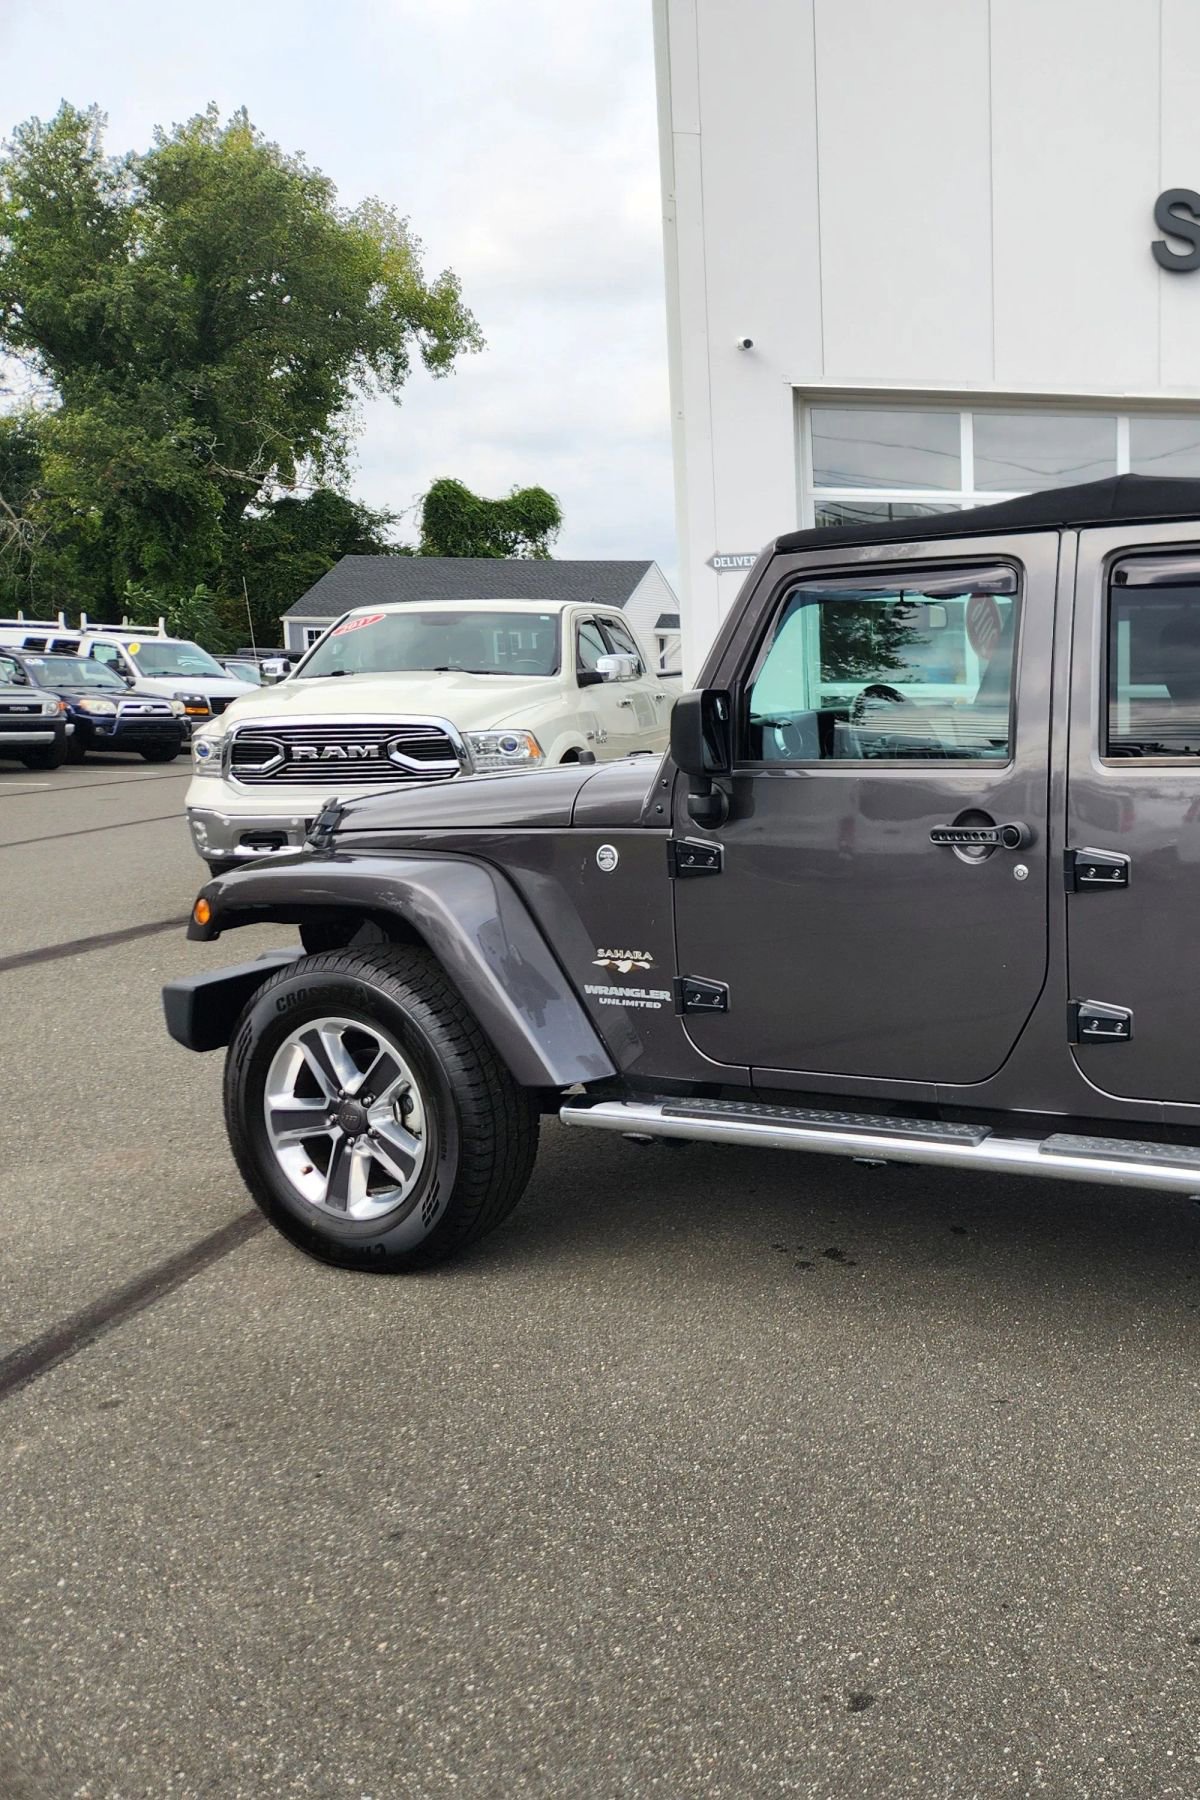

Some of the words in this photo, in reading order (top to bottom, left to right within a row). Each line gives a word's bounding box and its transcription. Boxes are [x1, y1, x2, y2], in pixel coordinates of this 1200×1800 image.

[291, 745, 380, 760] RAM
[597, 948, 653, 961] SAHARA
[584, 984, 672, 1001] WRANGLER
[599, 998, 662, 1009] UNLIMITED
